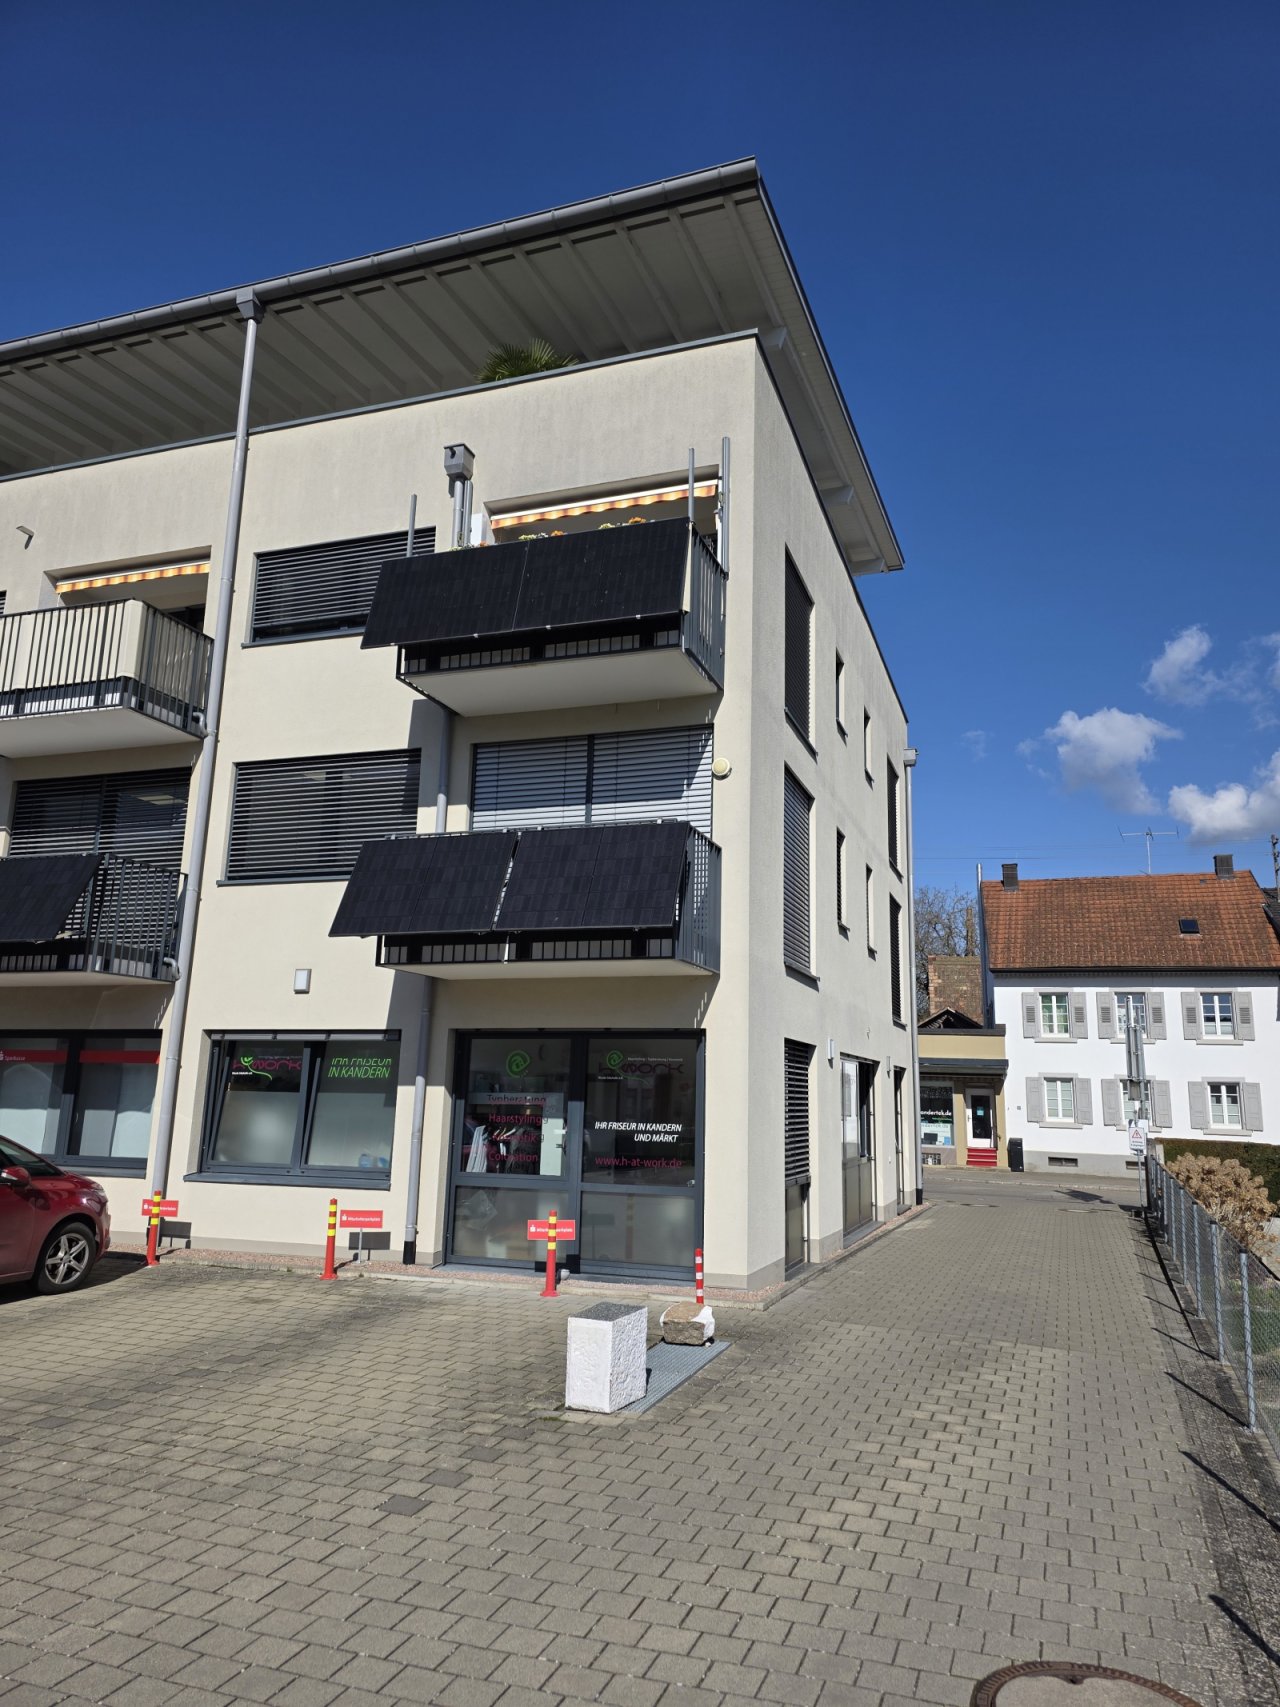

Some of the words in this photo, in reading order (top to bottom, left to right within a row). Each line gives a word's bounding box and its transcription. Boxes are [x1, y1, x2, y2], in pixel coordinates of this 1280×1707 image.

[328, 1066, 341, 1078] IN
[341, 1066, 391, 1079] KANDERN
[489, 1113, 542, 1127] Haarstyling
[595, 1121, 607, 1130] IHR
[608, 1122, 637, 1131] FRISEUR
[638, 1122, 647, 1131] IN
[646, 1123, 683, 1132] KANDERN
[634, 1133, 651, 1142] UND
[652, 1133, 679, 1143] MÄRKT
[595, 1156, 683, 1168] www.h-at-work.de
